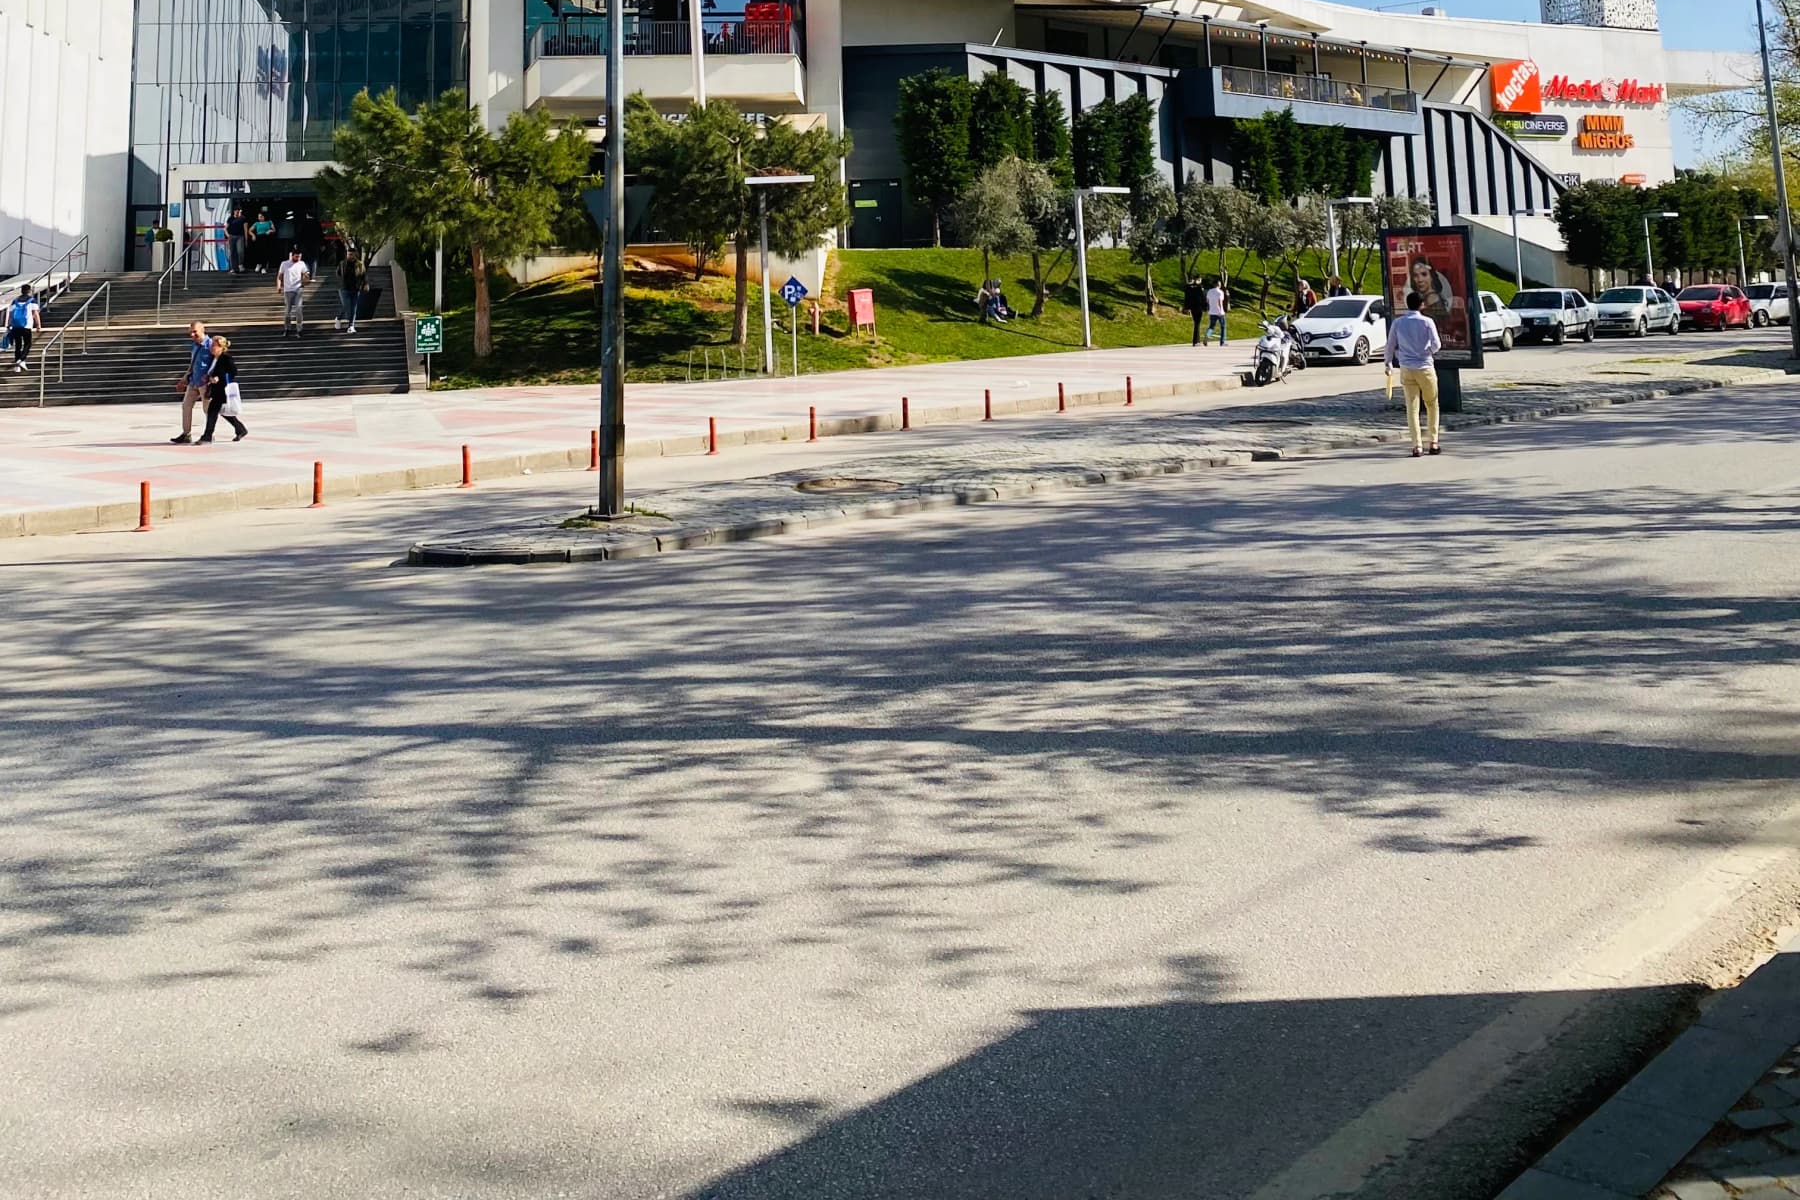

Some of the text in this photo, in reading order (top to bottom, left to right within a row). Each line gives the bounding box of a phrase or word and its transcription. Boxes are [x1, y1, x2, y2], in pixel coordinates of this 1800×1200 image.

[1544, 74, 1664, 104] Media Markt
[1584, 115, 1624, 132] MMM
[784, 285, 796, 300] P
